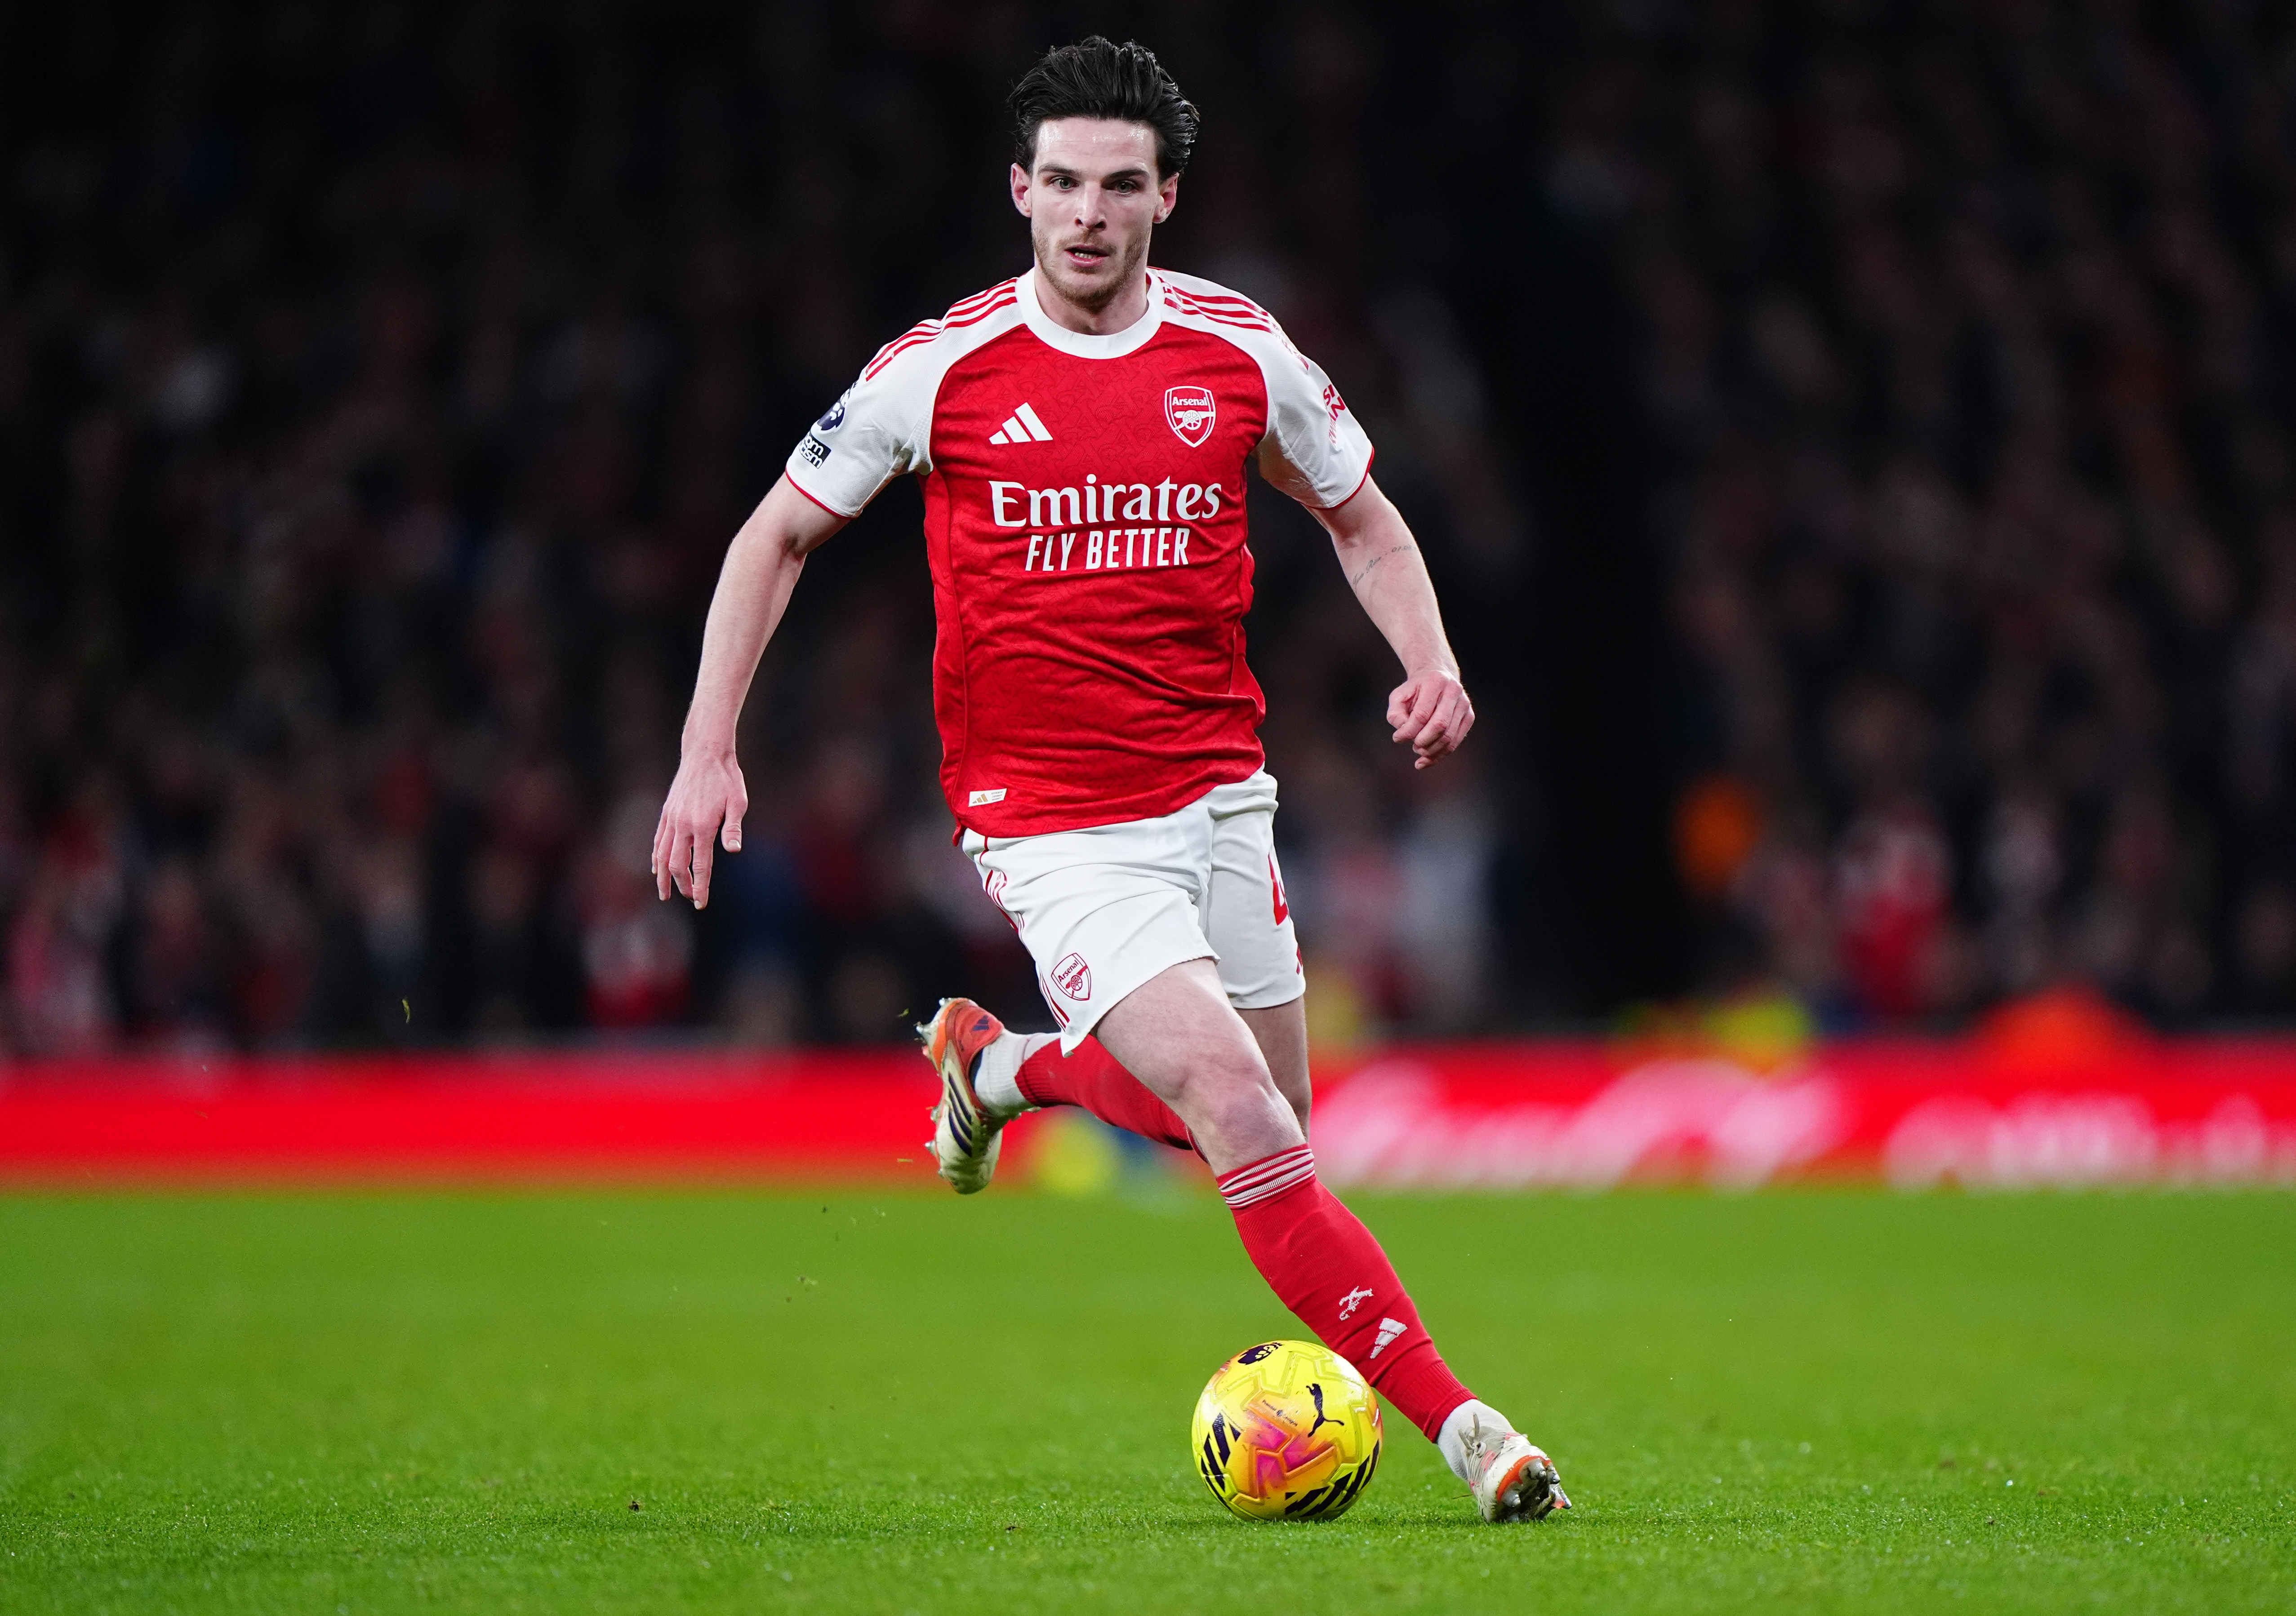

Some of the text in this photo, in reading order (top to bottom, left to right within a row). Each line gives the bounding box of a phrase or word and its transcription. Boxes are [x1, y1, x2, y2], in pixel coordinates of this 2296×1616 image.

[1172, 396, 1208, 406] Arsenal
[988, 474, 1222, 527] Emirates
[1025, 528, 1190, 571] FLY BETTER
[1058, 959, 1079, 982] Arsenal
